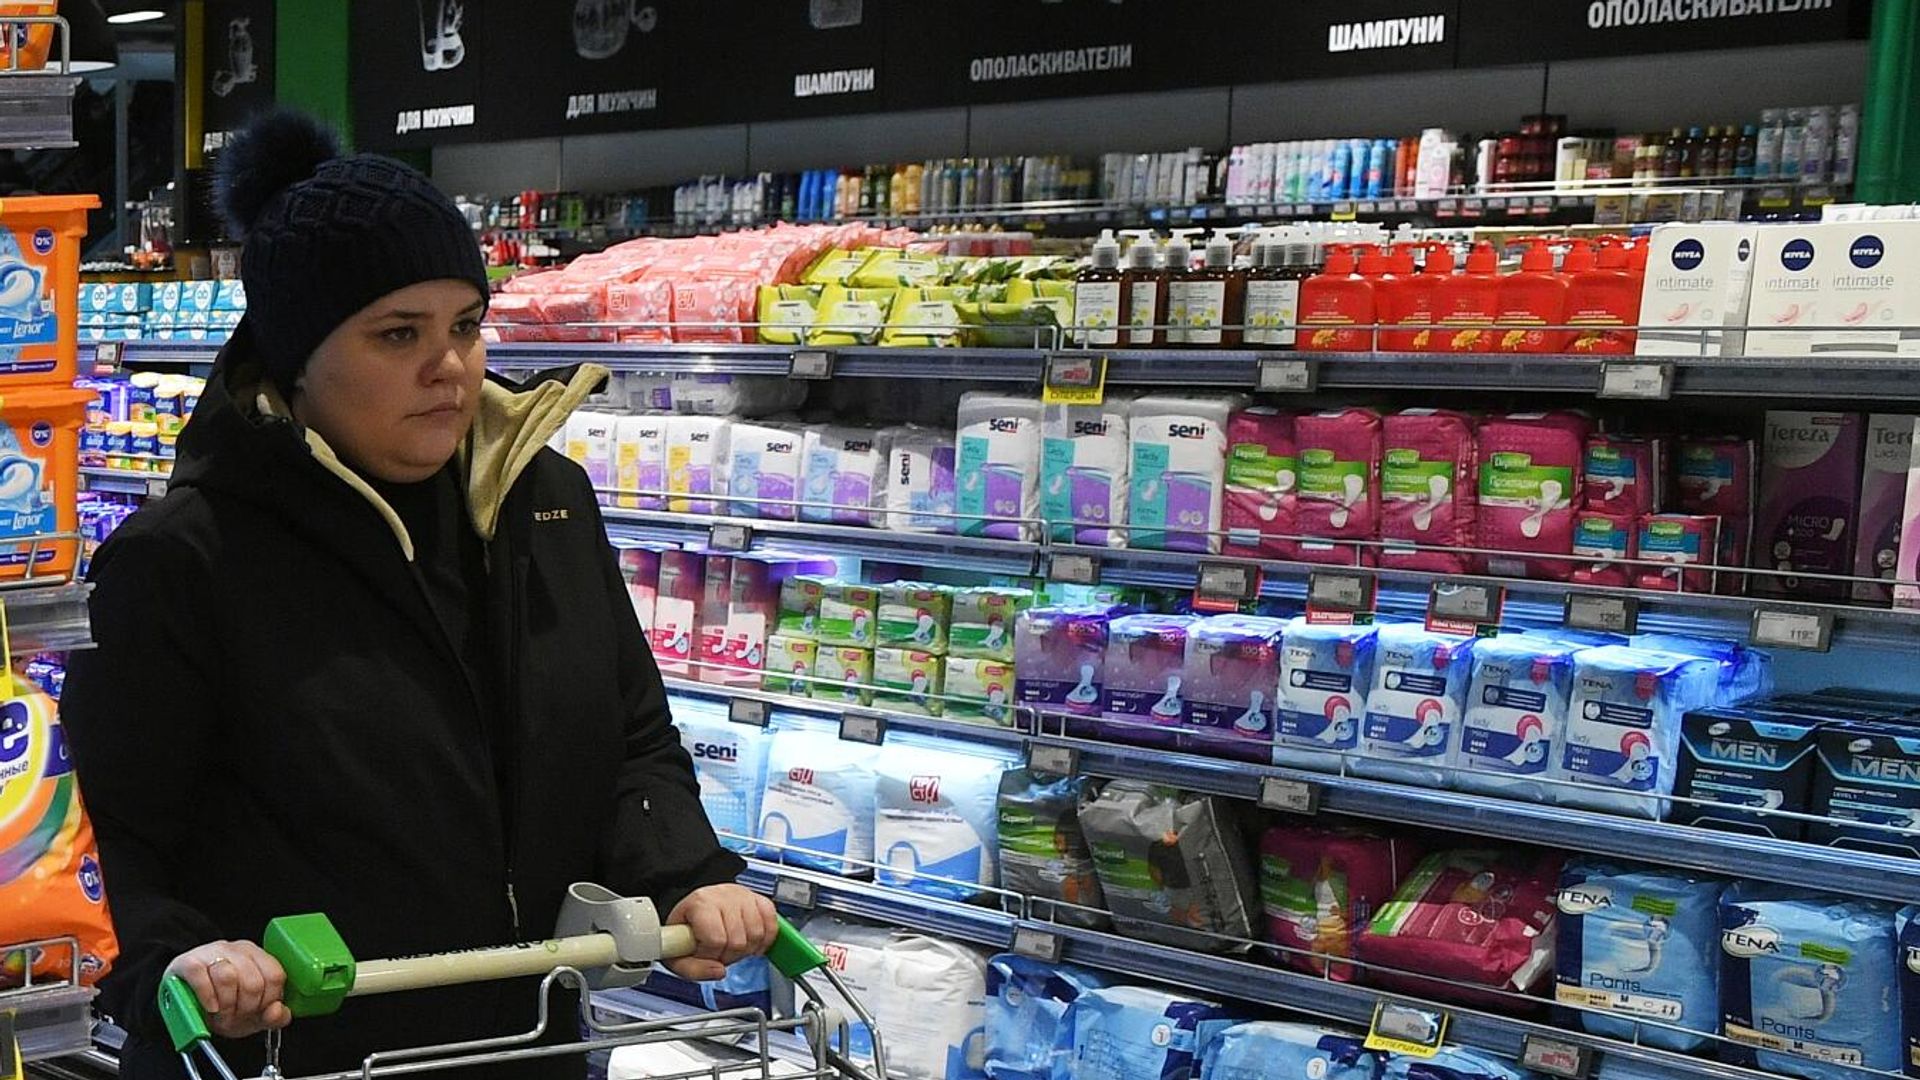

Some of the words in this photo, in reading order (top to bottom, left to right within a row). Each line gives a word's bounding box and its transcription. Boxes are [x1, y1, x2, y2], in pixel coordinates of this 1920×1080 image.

[1328, 15, 1444, 52] ШАМПУНИ
[971, 45, 1132, 81] ОПОЛАСКИВАТЕЛИ
[795, 69, 874, 97] ШАМПУНИ
[566, 94, 595, 119] ДЛЯ
[598, 89, 657, 113] МУЖЧИН
[396, 110, 421, 134] ДЛЯ
[423, 105, 474, 129] МУЖЧИН
[36, 237, 50, 246] 0%
[1675, 251, 1701, 259] NIVEA
[1784, 250, 1811, 259] NIVEA
[1853, 248, 1881, 257] NIVEA
[1656, 276, 1713, 289] intimate
[1833, 273, 1894, 288] intimate
[13, 321, 44, 338] Lenor
[588, 427, 606, 437] seni
[640, 427, 658, 438] seni
[989, 418, 1018, 433] seni
[1075, 420, 1108, 436] seni
[1169, 423, 1205, 438] seni
[691, 431, 710, 441] seni
[767, 441, 793, 453] seni
[845, 439, 873, 451] seni
[900, 452, 910, 485] seni
[13, 513, 44, 530] Lenor
[535, 509, 568, 521] EDZE
[1386, 650, 1414, 661] TENA
[1483, 664, 1511, 675] TENA
[1582, 678, 1613, 690] TENA
[694, 743, 737, 761] seni
[1711, 740, 1777, 764] MEN
[1851, 756, 1920, 782] MEN
[1558, 889, 1611, 907] TENA
[1723, 931, 1780, 953] TENA
[1590, 972, 1640, 992] Pants
[1761, 1017, 1815, 1040] Pants
